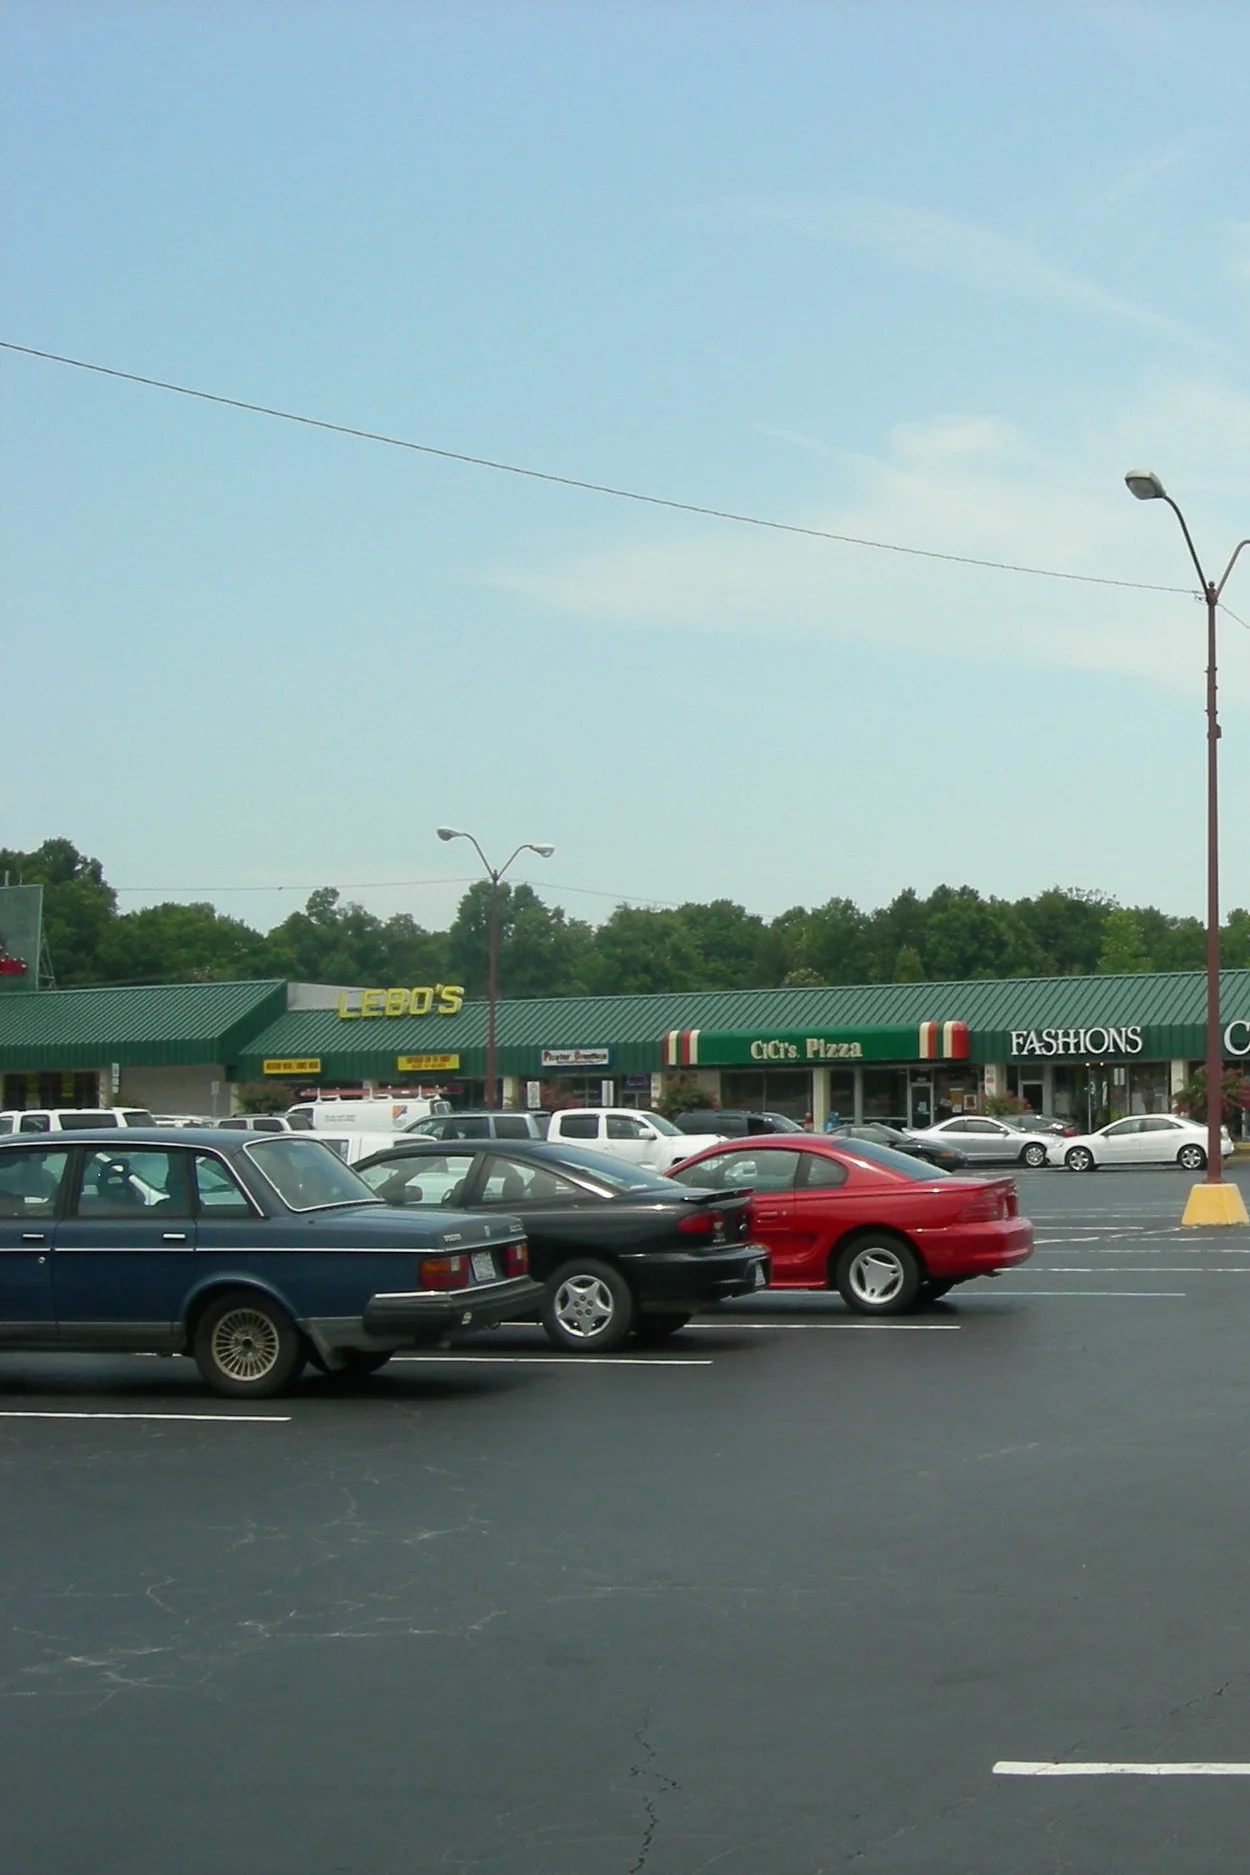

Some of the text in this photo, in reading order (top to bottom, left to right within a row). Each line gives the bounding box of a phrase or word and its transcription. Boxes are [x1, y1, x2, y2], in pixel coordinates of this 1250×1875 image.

[337, 983, 465, 1018] LEBO'S
[805, 1038, 864, 1059] Pizza
[1010, 1025, 1143, 1056] FASHIONS
